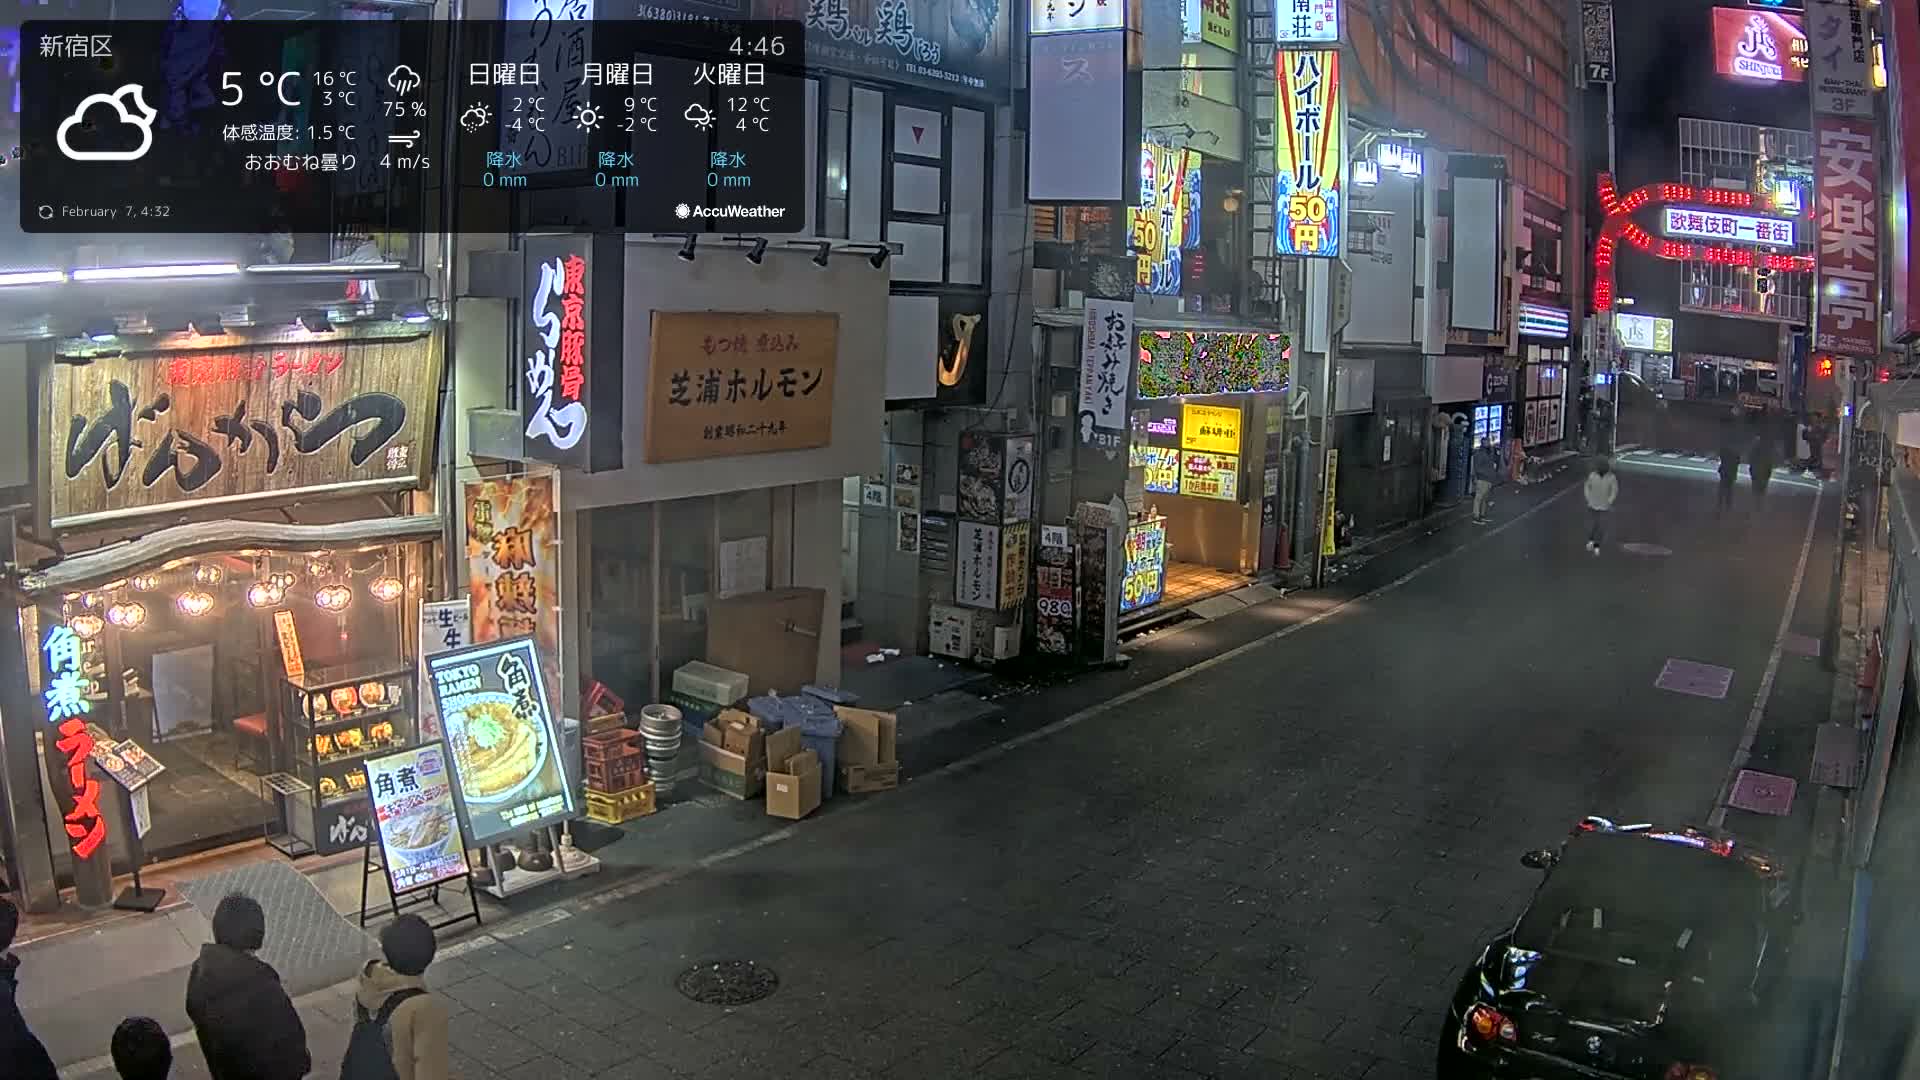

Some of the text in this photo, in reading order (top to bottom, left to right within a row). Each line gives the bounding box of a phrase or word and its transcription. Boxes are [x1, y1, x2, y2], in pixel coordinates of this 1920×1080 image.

[1589, 63, 1610, 80] 7F
[1295, 52, 1322, 191] ハイボール
[1289, 195, 1326, 252] 50円
[1670, 211, 1789, 242] 歌舞伎町一番街
[1820, 128, 1875, 329] 安楽亭
[560, 254, 586, 401] 東京豚骨
[668, 367, 824, 408] 芝浦ホルモン
[1098, 309, 1127, 416] お好み焼き
[43, 626, 90, 722] 角煮
[435, 664, 480, 684] TOKYO
[439, 678, 481, 697] RAMEN
[500, 655, 537, 720] 角煮
[56, 718, 106, 859] ラーメン
[374, 765, 419, 799] 角煮
